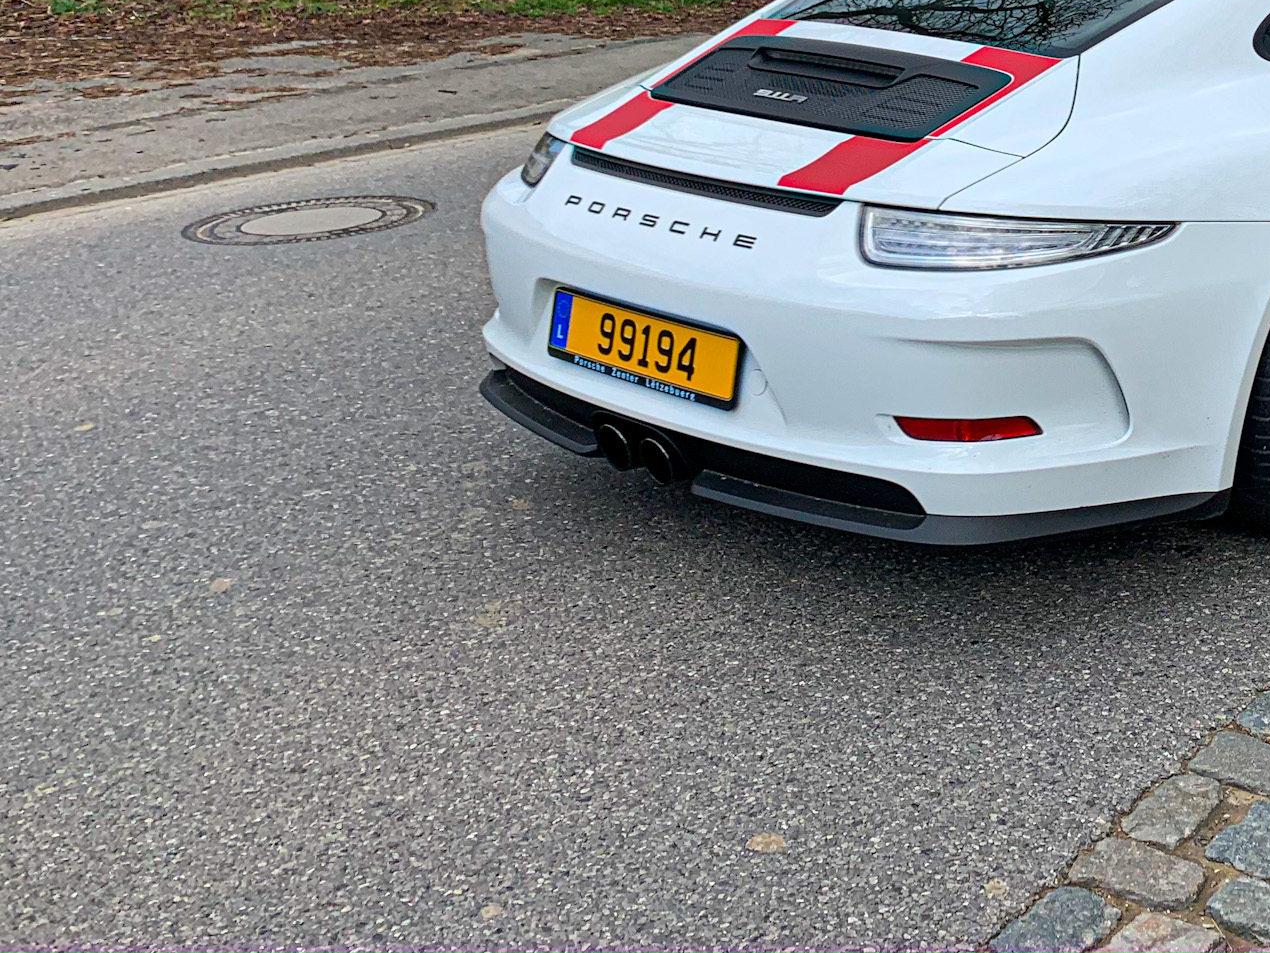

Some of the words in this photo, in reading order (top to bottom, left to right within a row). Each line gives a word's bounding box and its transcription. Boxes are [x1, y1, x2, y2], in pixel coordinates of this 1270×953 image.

[564, 194, 757, 250] PORSCHE
[556, 323, 564, 339] L
[597, 312, 697, 382] 99194
[573, 355, 606, 373] Porsche
[611, 367, 640, 384] Zenter
